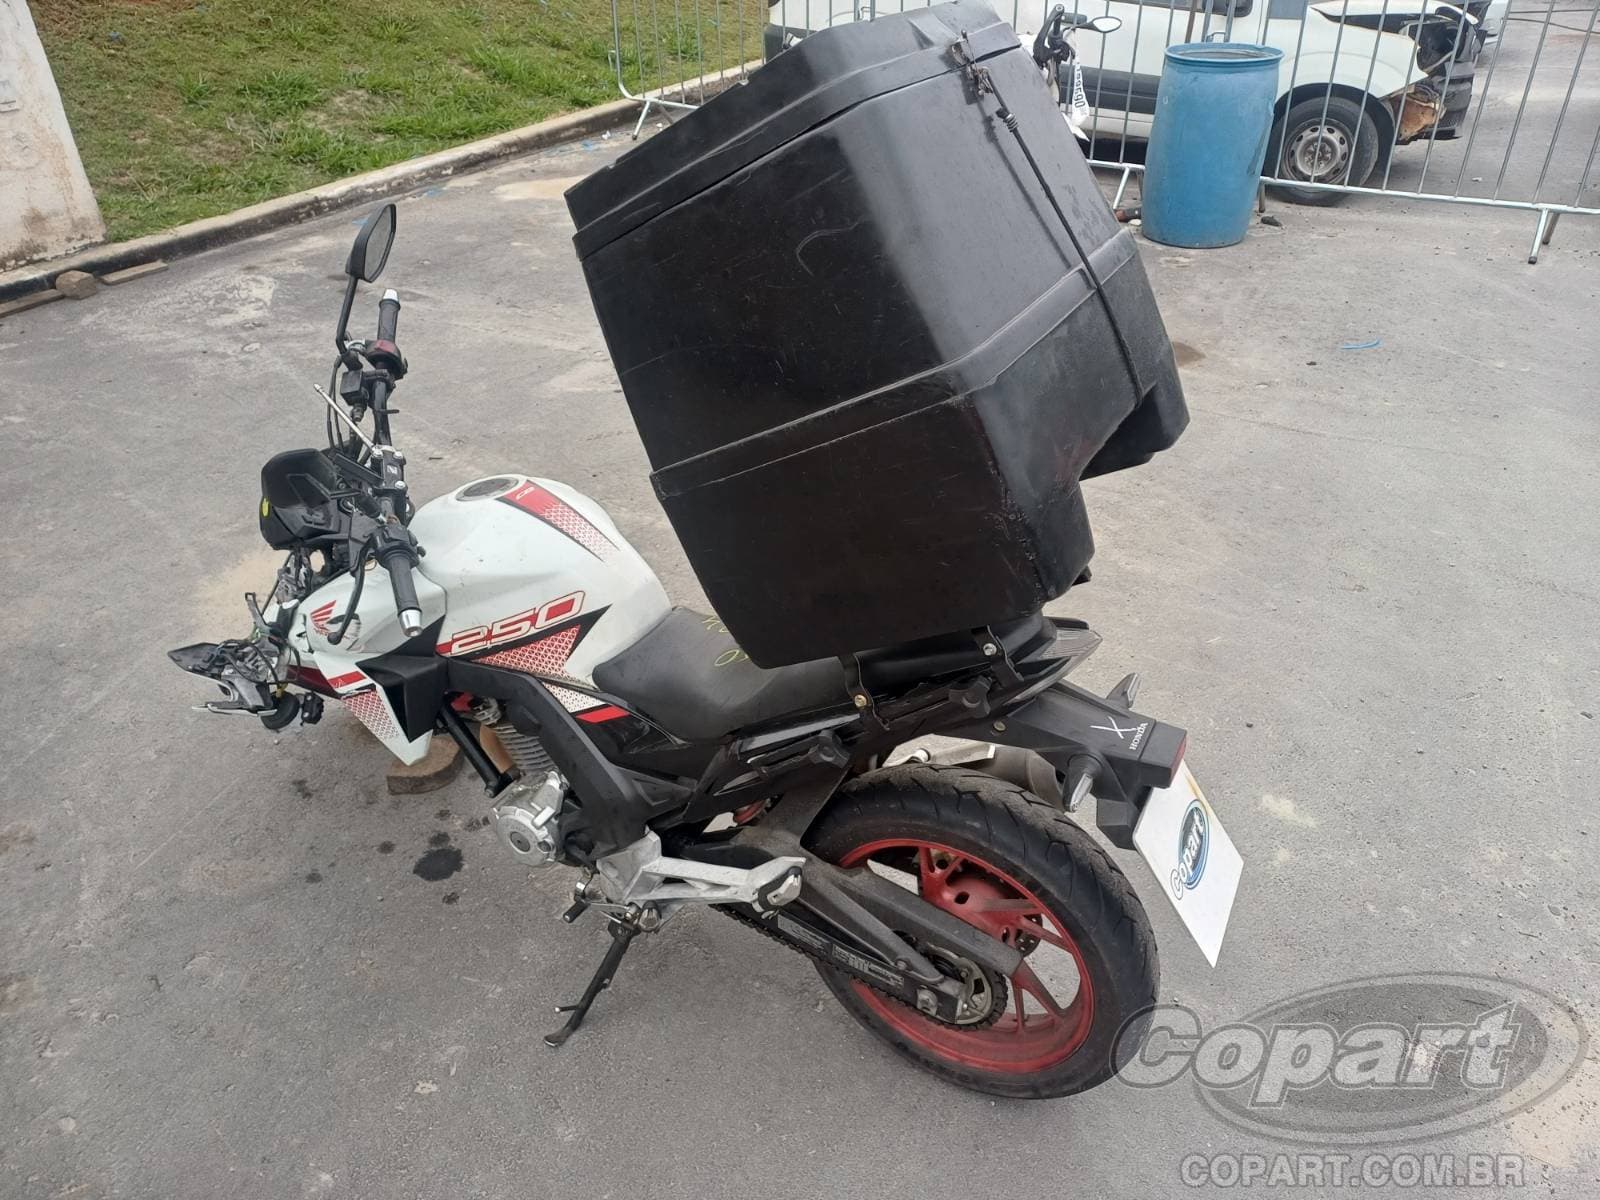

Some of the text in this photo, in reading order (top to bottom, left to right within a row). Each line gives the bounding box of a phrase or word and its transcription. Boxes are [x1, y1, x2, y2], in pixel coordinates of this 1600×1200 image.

[449, 590, 585, 656] 250
[1129, 723, 1148, 750] HONDA
[1170, 809, 1205, 901] Copart
